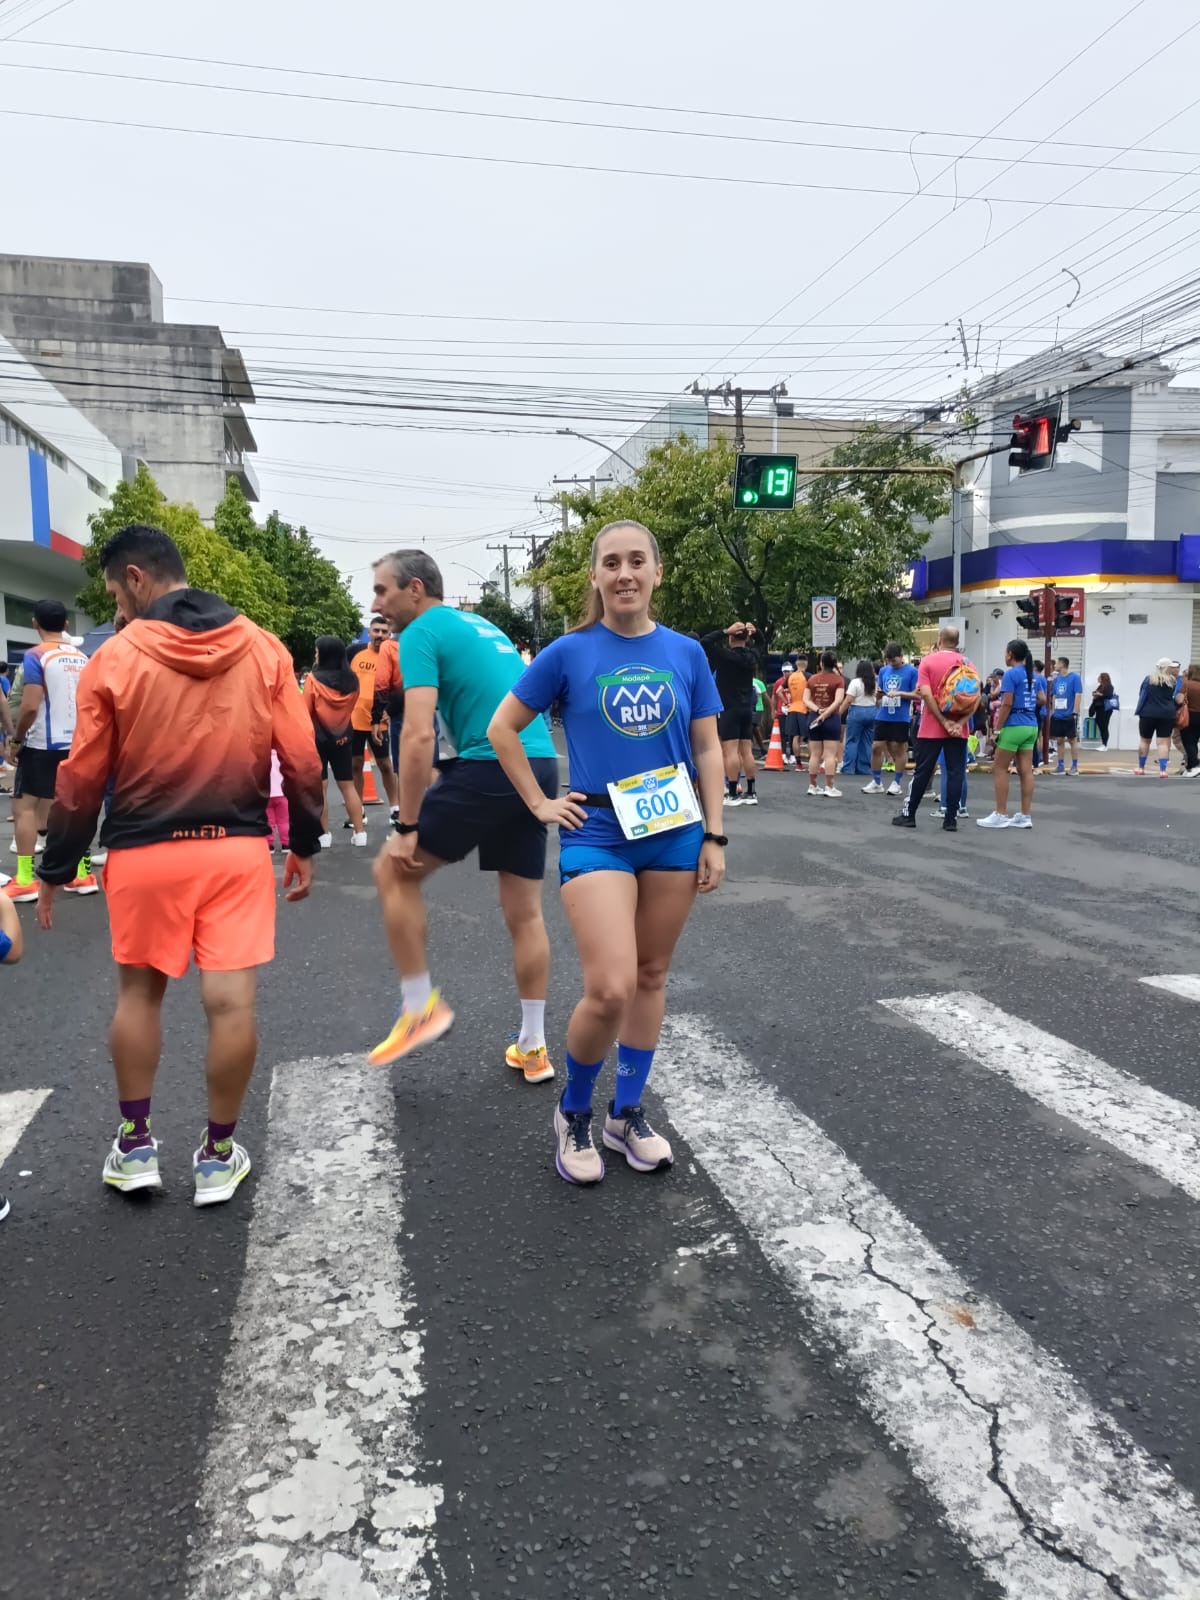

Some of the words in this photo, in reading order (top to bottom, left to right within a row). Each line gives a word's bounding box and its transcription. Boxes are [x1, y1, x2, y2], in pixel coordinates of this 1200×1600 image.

[767, 468, 789, 496] 13
[821, 606, 829, 619] E
[620, 703, 661, 723] RUN
[635, 790, 679, 820] 600
